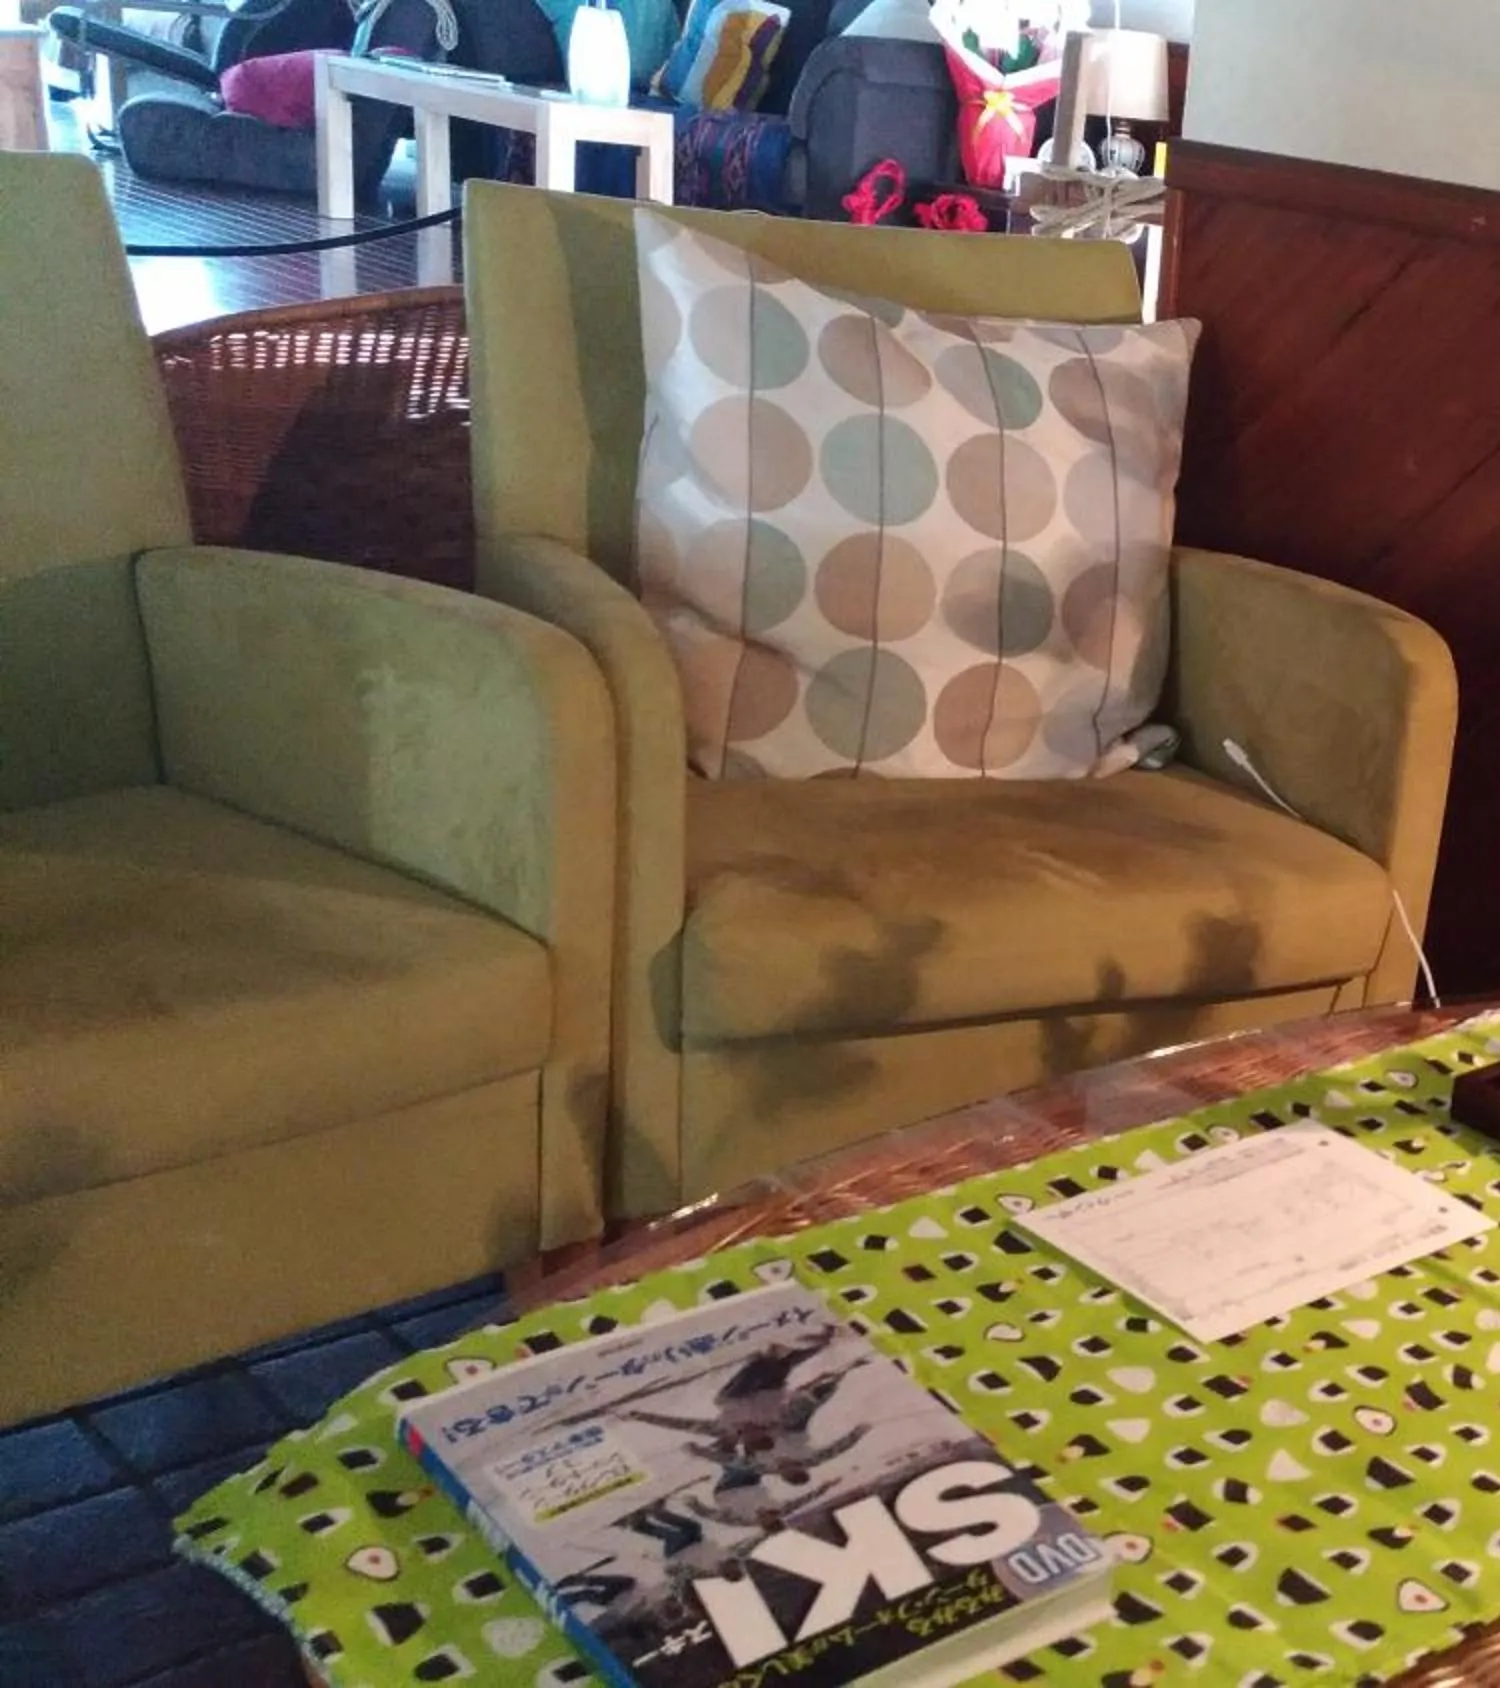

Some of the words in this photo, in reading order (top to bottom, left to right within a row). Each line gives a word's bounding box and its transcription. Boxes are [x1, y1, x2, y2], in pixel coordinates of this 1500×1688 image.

[693, 1460, 1041, 1669] SKI
[1008, 1532, 1100, 1585] DVD
[906, 1584, 1003, 1638] みるみる
[632, 1620, 713, 1667] スキー
